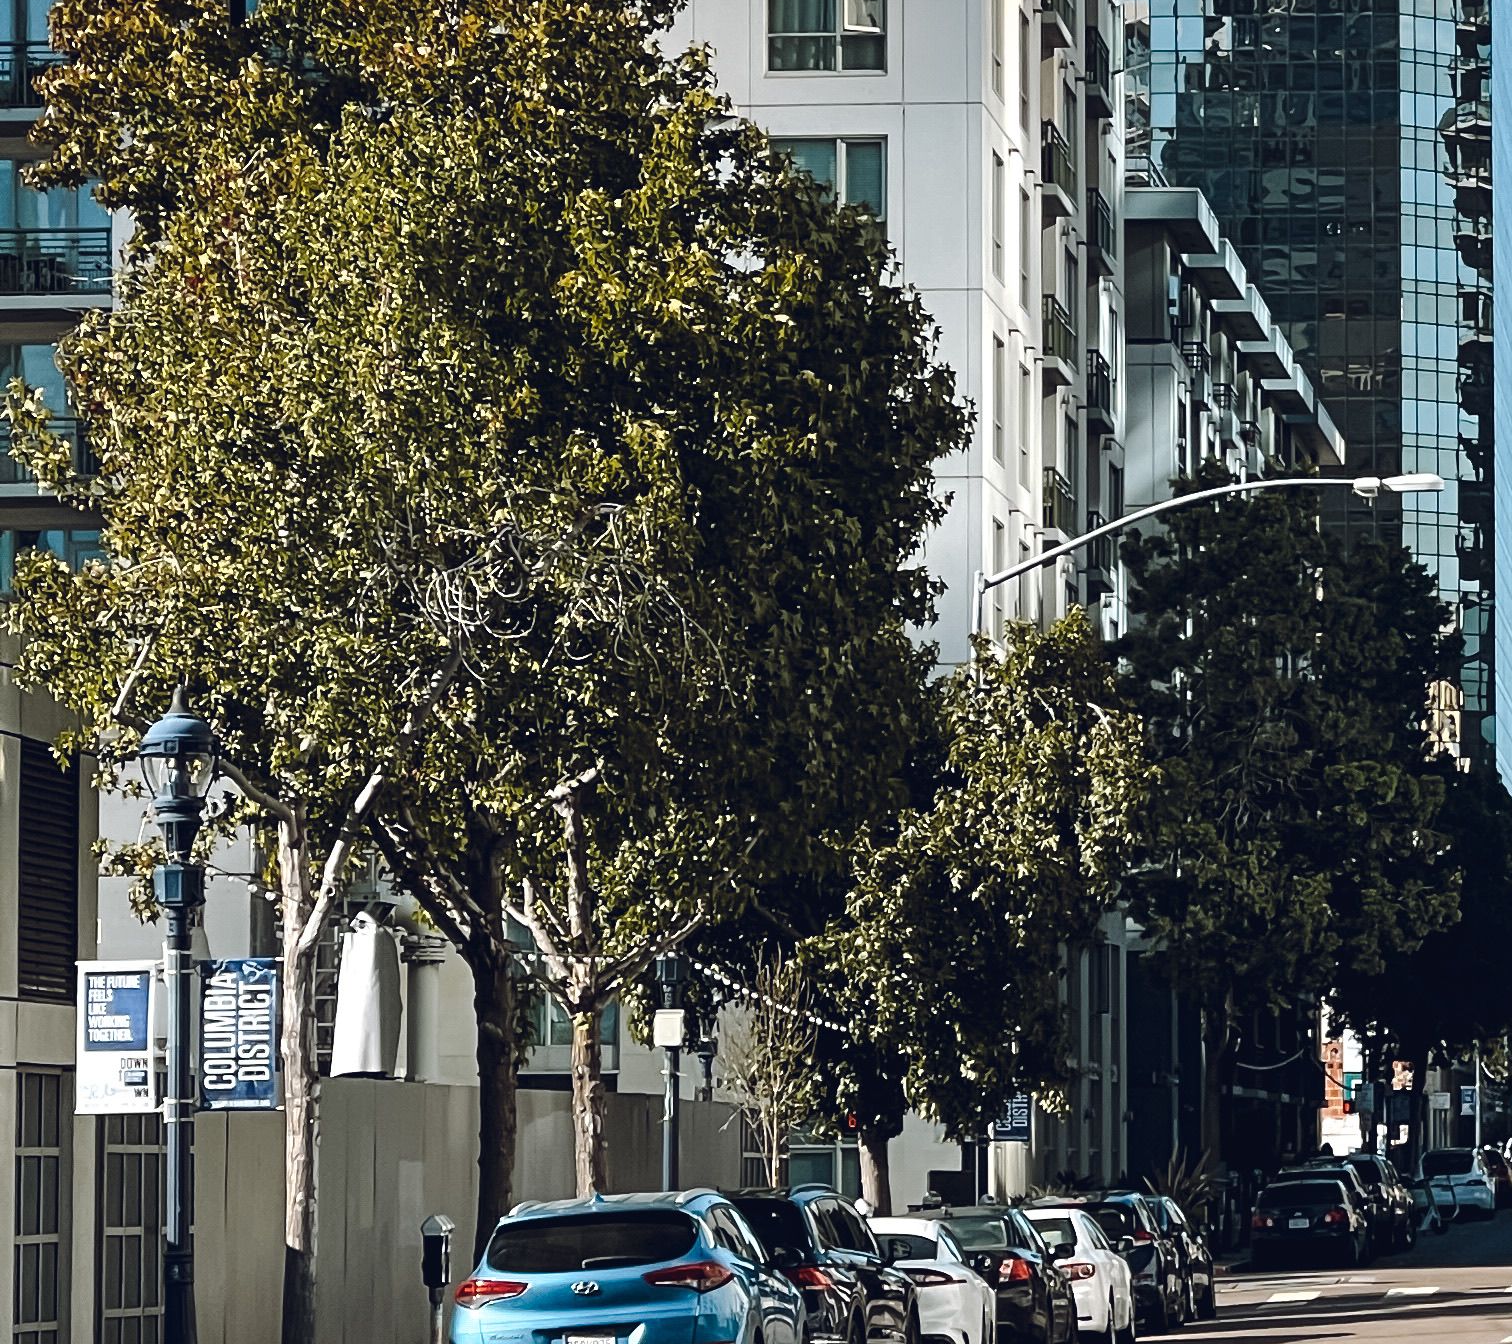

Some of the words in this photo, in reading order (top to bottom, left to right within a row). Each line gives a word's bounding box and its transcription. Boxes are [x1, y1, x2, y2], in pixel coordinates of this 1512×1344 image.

[88, 976, 105, 989] THE
[107, 975, 140, 989] FUTURE
[88, 988, 113, 1002] FEELS
[88, 1002, 107, 1016] LIKE
[88, 1015, 130, 1028] WORKING
[203, 972, 237, 1090] COLUMBIA
[237, 980, 271, 1081] DISTRICT
[120, 1058, 148, 1069] DOWN
